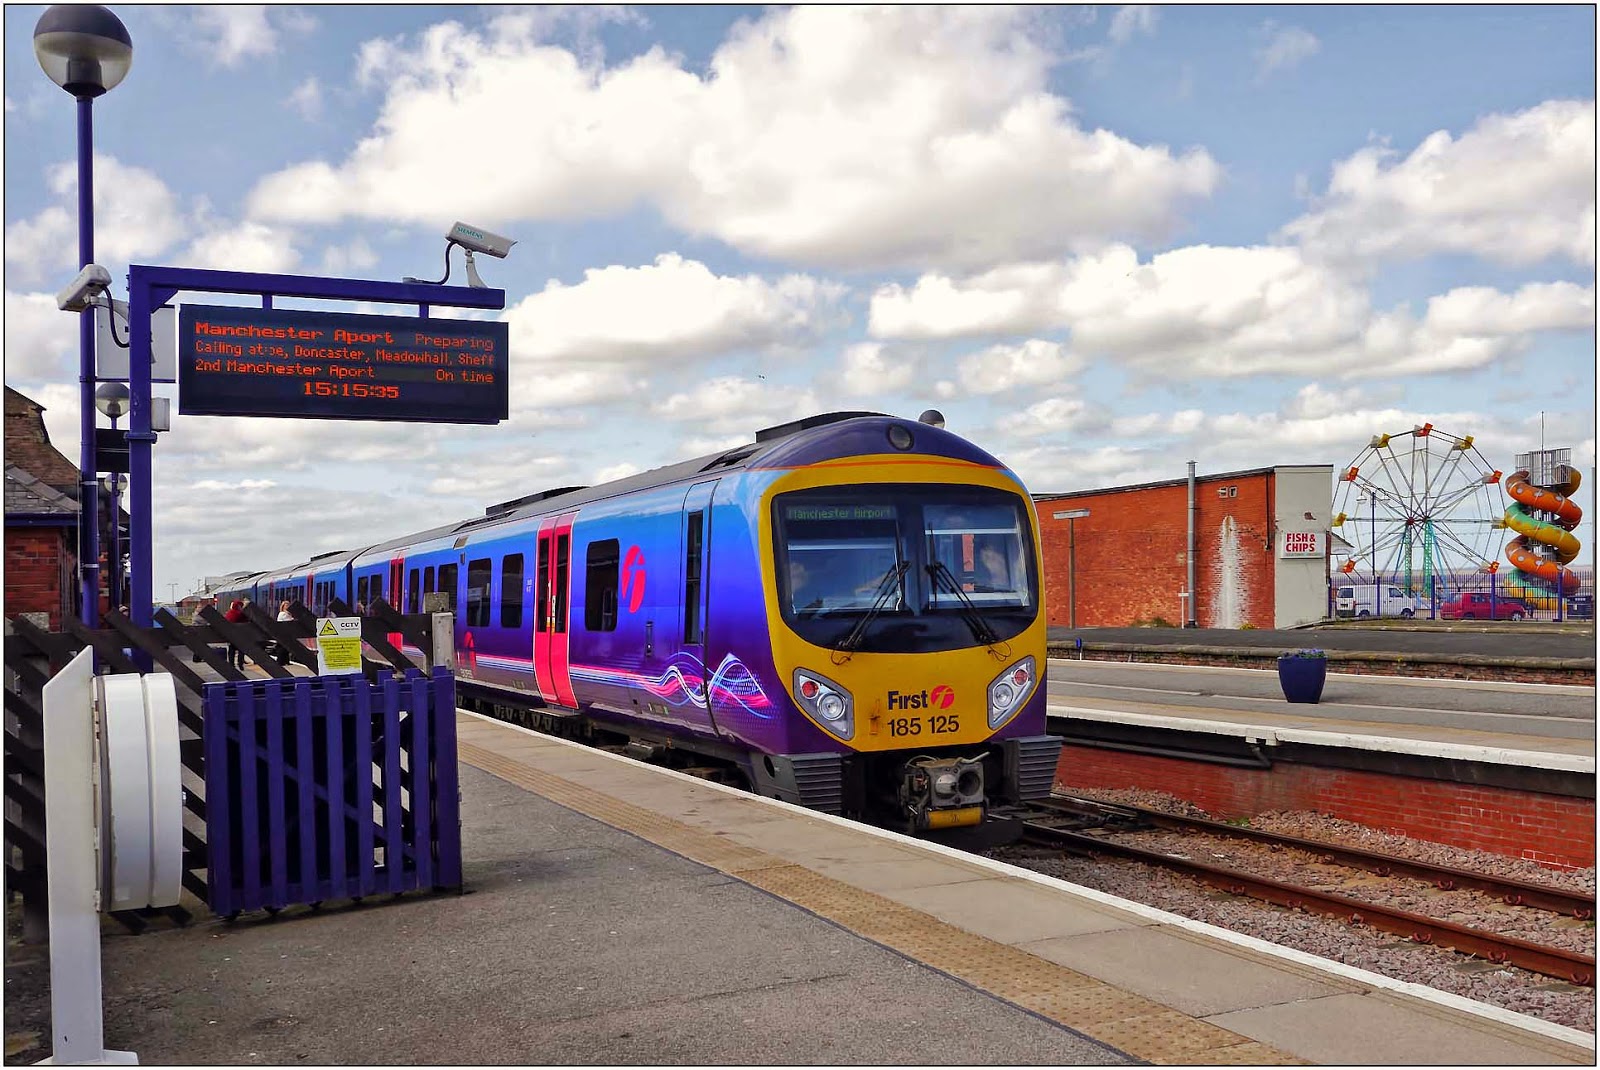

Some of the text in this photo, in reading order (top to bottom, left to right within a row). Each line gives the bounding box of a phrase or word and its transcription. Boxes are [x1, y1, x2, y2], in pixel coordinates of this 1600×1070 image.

[457, 226, 484, 239] SIEMENS
[195, 321, 394, 345] Manchester Aport
[415, 332, 495, 352] Preparing
[294, 344, 370, 363] Doncaster,
[458, 352, 495, 366] Sheff
[195, 359, 375, 380] 2nd Manchester Aport
[436, 368, 495, 384] On time
[1286, 533, 1316, 542] FISH &
[1286, 543, 1315, 552] CHIPS
[887, 690, 928, 710] First
[887, 715, 960, 737] 185 125
